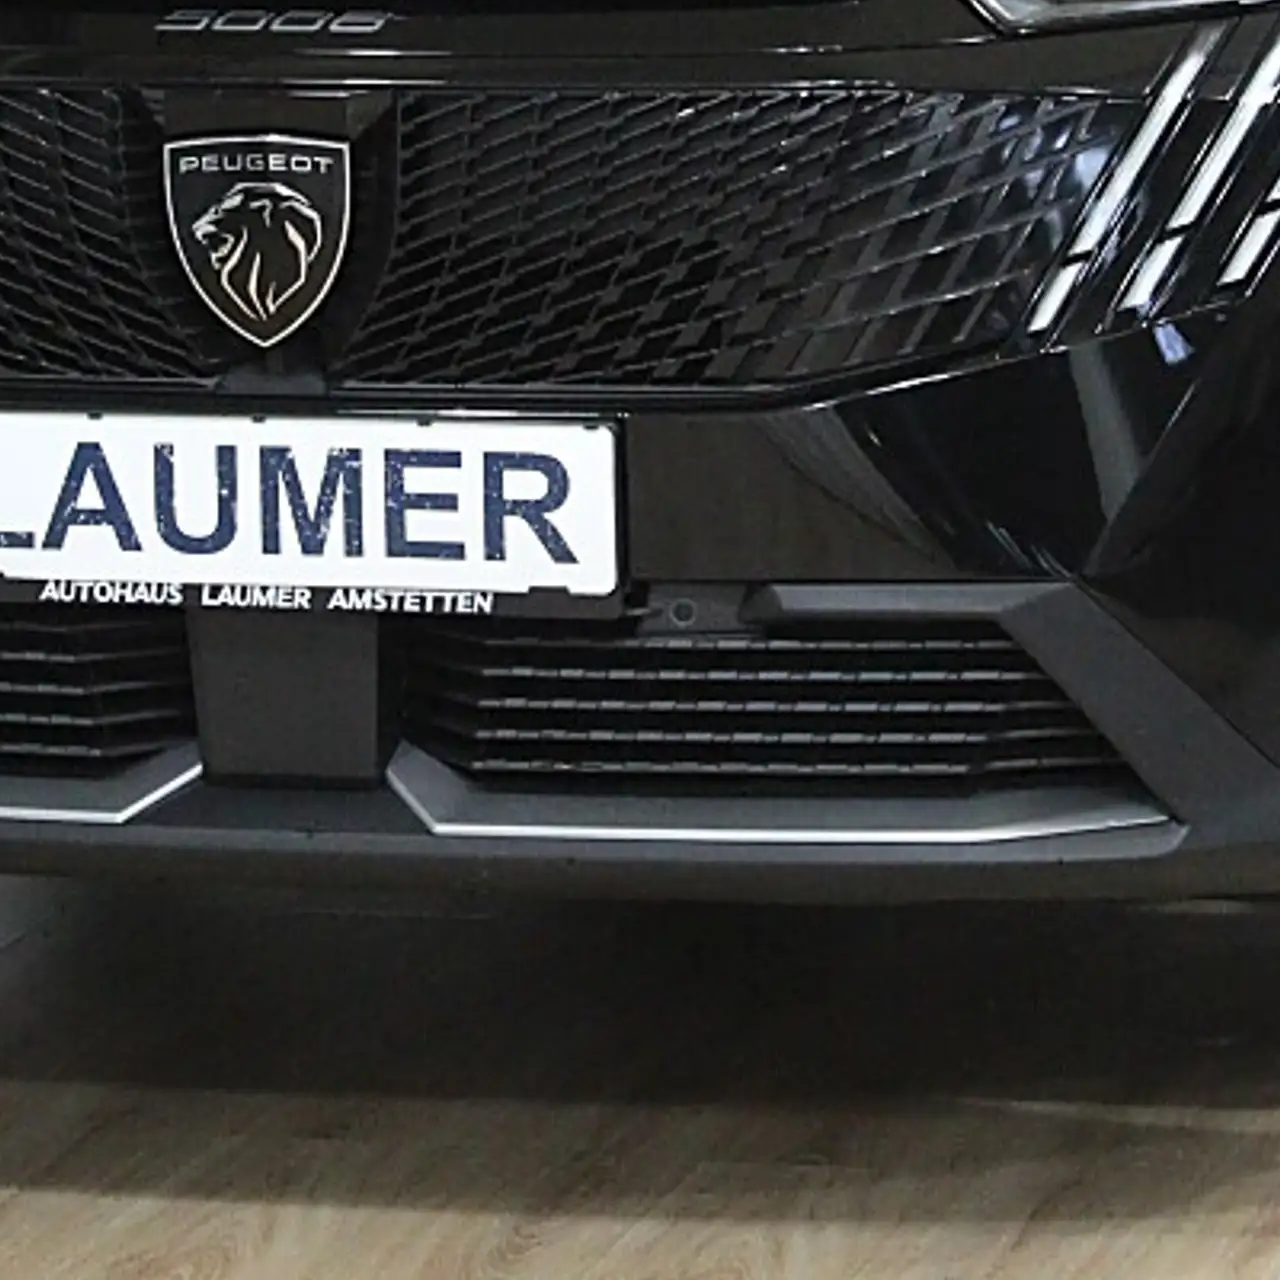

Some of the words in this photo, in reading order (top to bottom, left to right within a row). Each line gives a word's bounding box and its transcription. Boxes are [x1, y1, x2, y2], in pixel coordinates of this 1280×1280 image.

[178, 152, 335, 174] PEUGEOT
[40, 578, 184, 606] AUTOHAUS
[200, 583, 312, 610] LAUMER
[327, 586, 495, 614] AMSTETTEN
